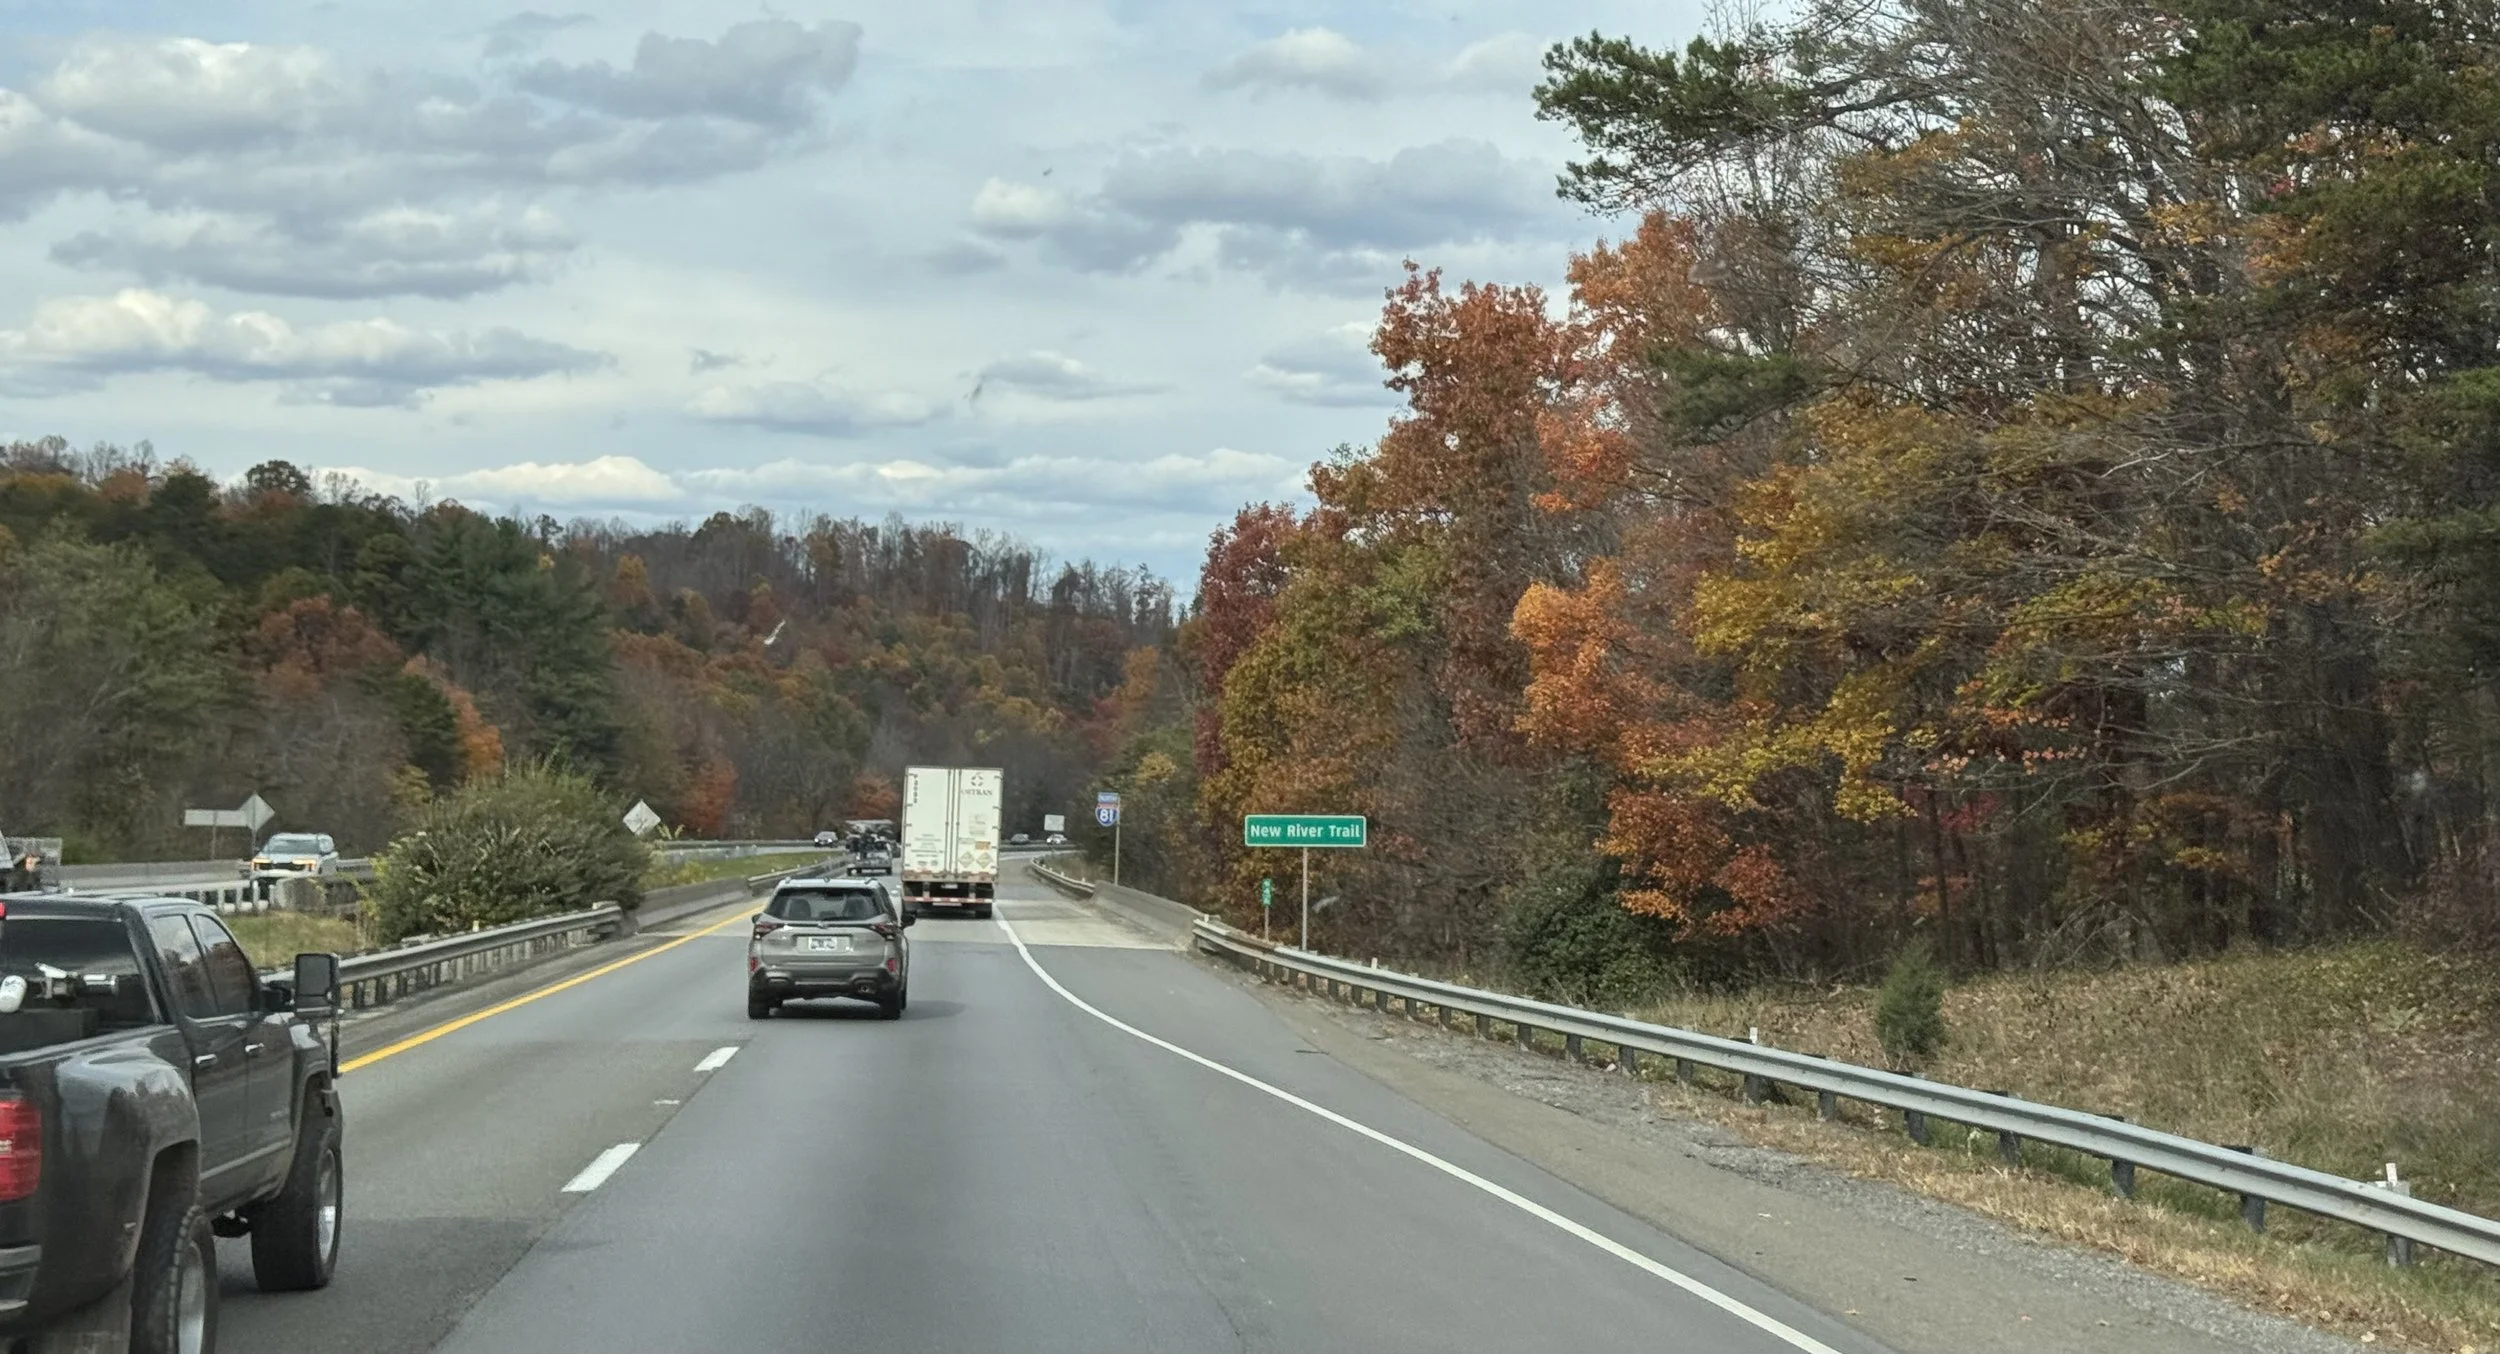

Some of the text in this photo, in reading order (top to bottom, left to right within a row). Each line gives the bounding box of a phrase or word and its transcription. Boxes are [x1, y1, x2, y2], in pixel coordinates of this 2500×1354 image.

[1099, 809, 1114, 822] 81
[1250, 824, 1361, 837] New River Trail
